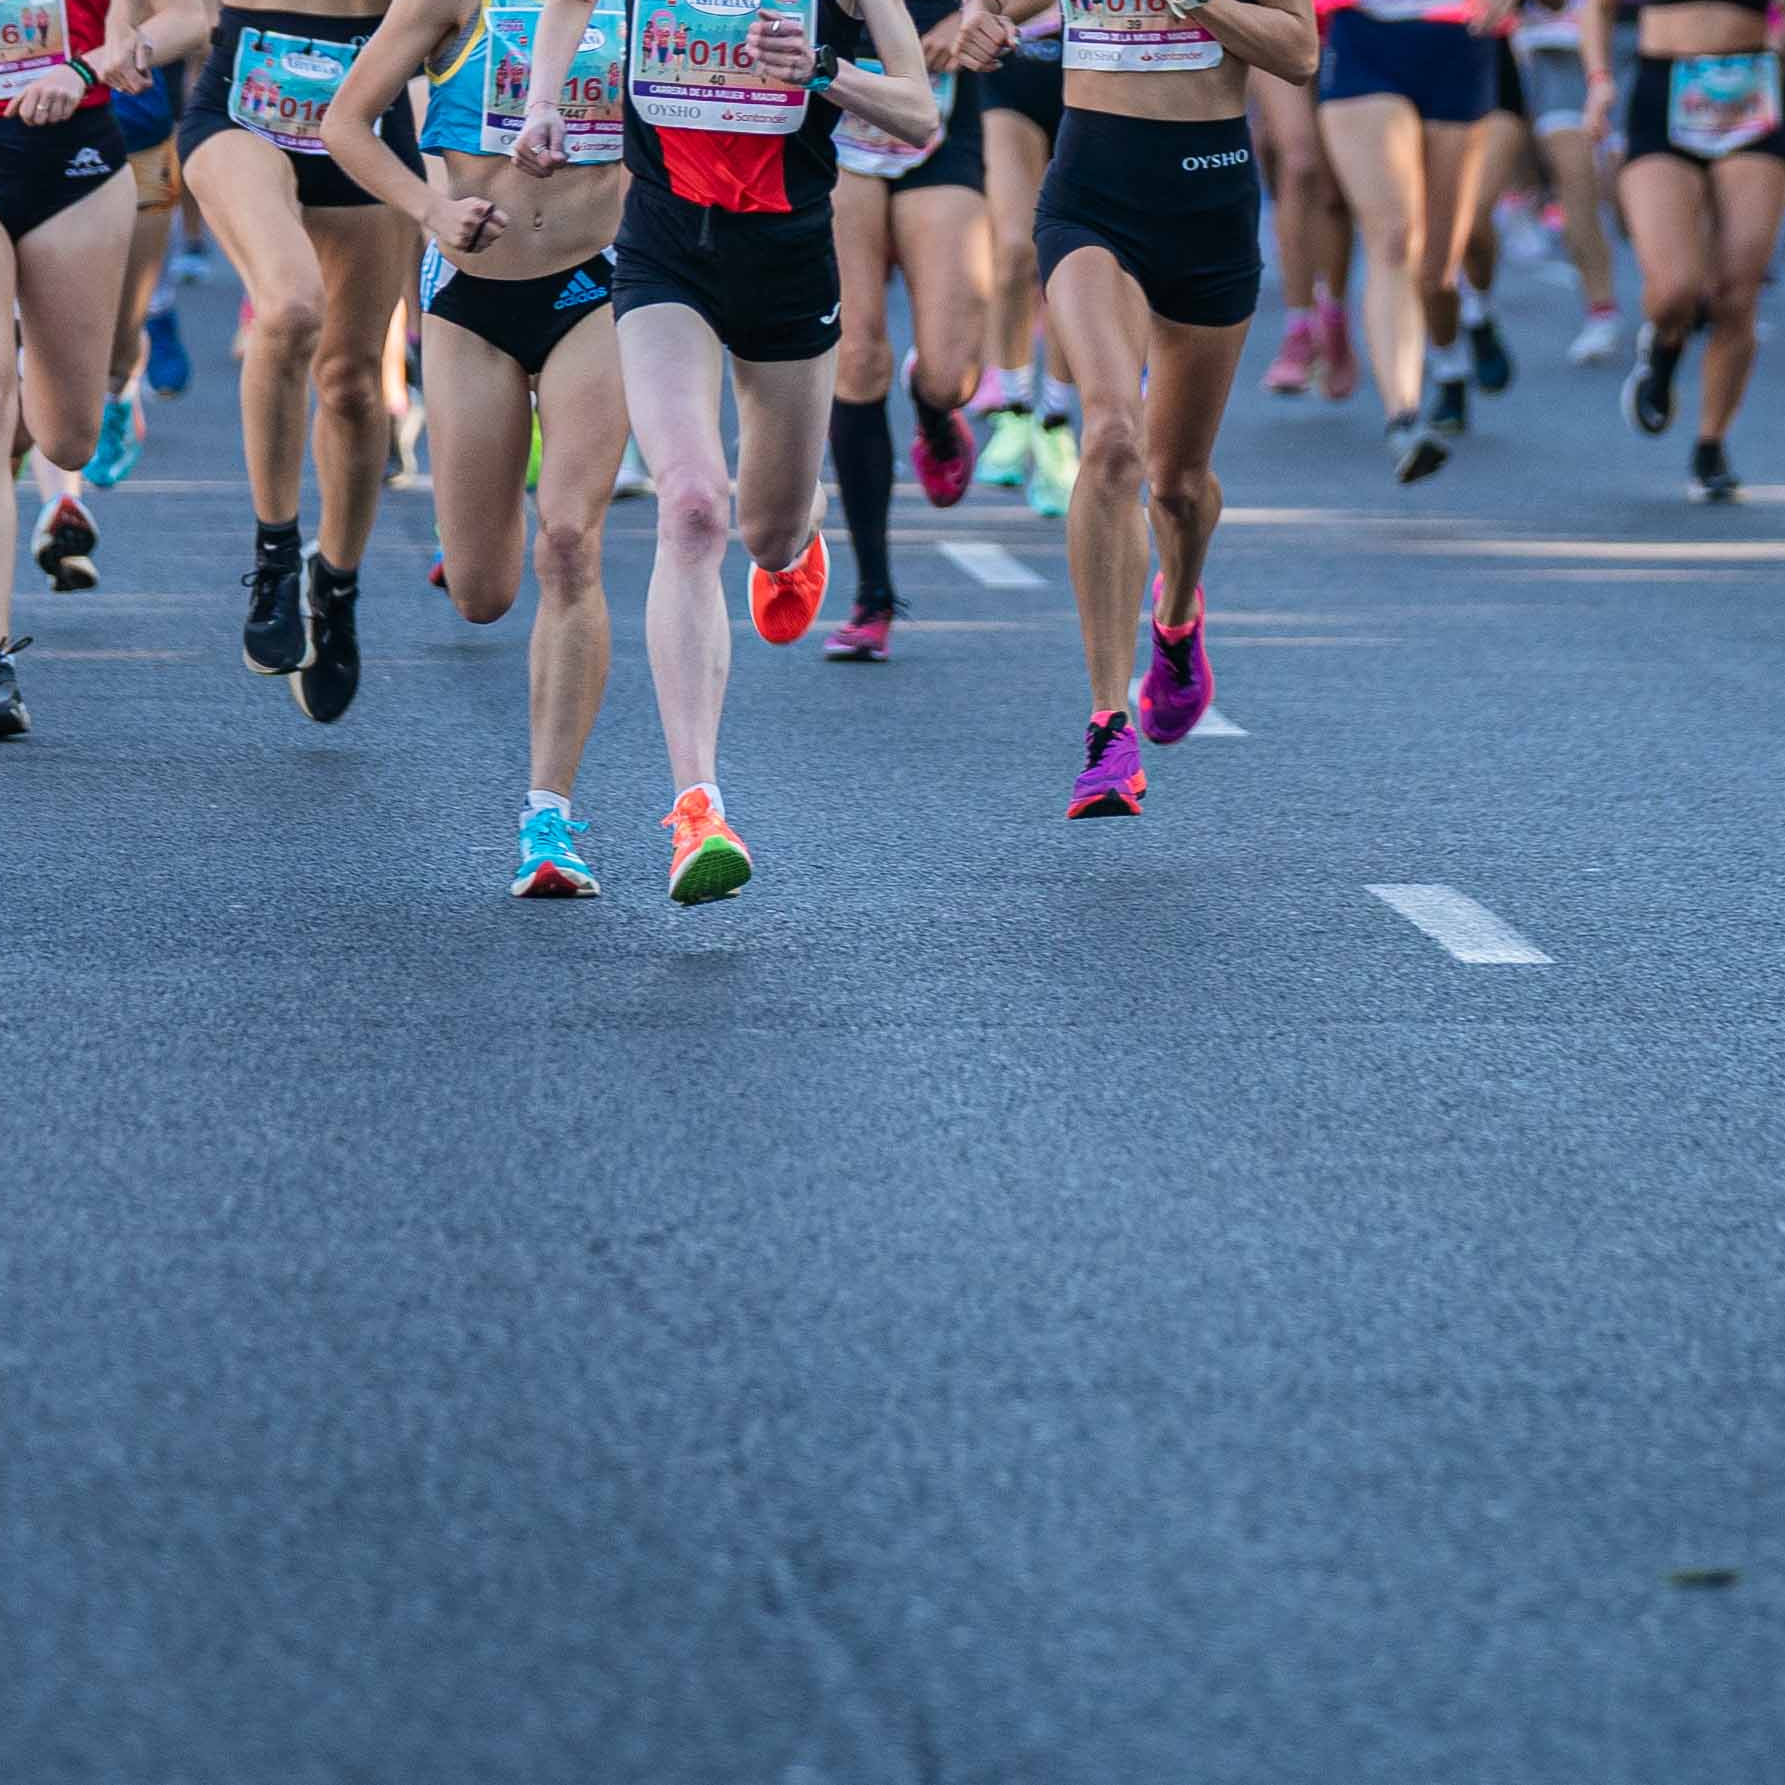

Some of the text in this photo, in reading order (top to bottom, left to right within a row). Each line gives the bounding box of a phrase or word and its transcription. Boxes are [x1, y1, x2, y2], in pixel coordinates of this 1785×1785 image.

[1127, 19, 1142, 30] 39
[688, 39, 755, 69] 016
[564, 77, 604, 102] 16
[709, 74, 726, 86] 40
[647, 102, 702, 120] OYSHO
[735, 111, 788, 124] Santander
[1181, 148, 1249, 172] OYSHO
[553, 285, 608, 311] adidas
